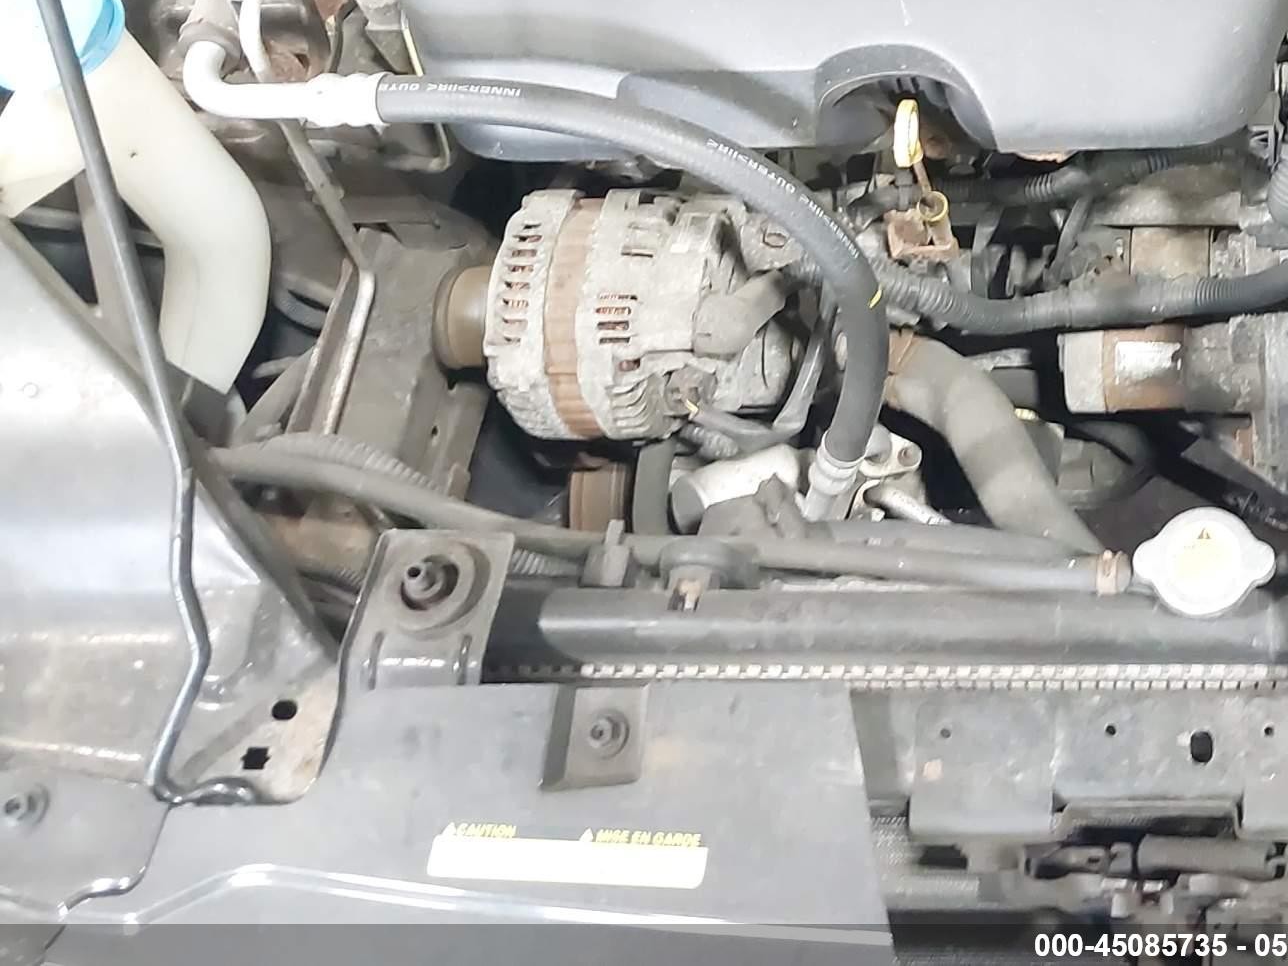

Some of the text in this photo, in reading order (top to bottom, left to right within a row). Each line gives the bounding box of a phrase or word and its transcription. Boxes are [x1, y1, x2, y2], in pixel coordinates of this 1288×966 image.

[457, 822, 517, 838] CAUTION
[596, 828, 701, 847] MISE EN GARDE
